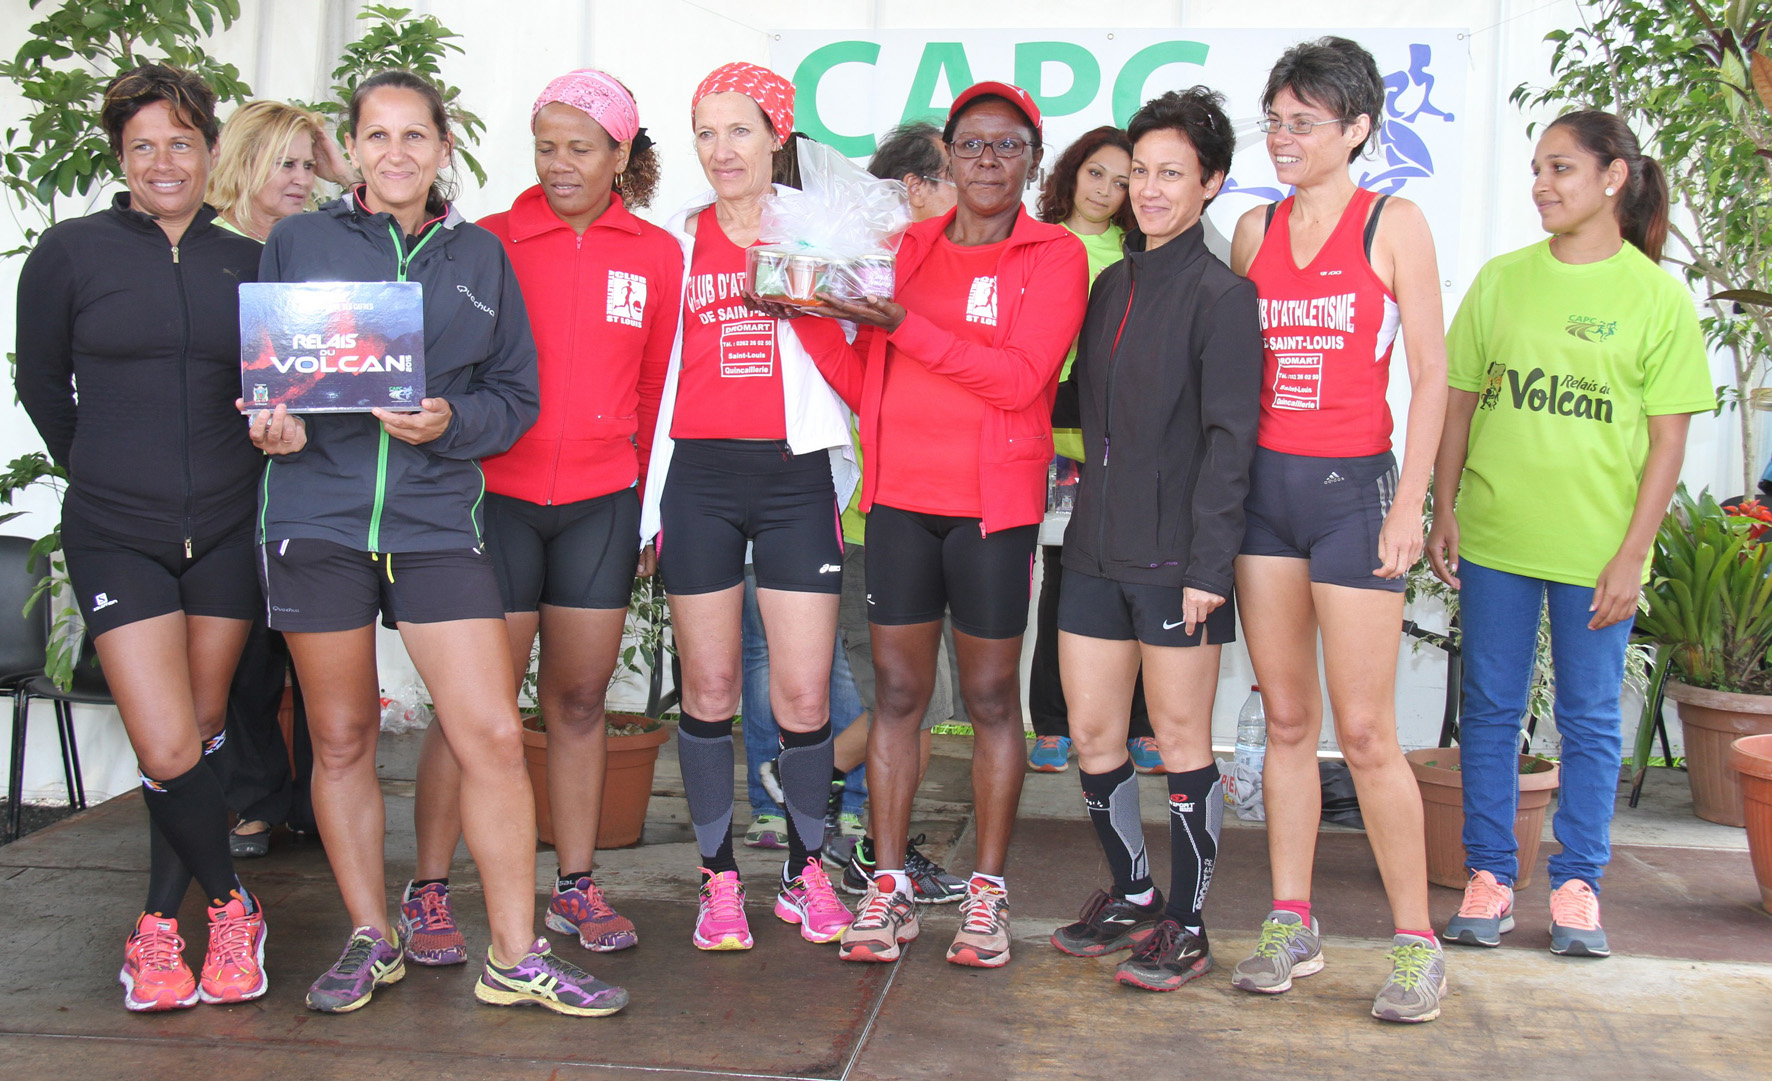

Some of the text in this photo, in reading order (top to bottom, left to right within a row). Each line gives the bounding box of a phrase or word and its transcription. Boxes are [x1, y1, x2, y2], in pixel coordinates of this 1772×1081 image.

[792, 40, 1210, 158] CAPC
[613, 270, 647, 284] CLUB
[456, 284, 496, 317] Quechua
[686, 273, 716, 314] CLUB
[698, 311, 717, 325] DE
[1270, 293, 1356, 333] D'ATHLETISME
[1568, 314, 1598, 324] CAPC
[606, 315, 643, 329] ST LOUIS
[725, 324, 771, 334] DROMART
[292, 333, 359, 350] RELAIS
[1269, 335, 1345, 350] SAINT-LOUIS
[269, 355, 405, 374] VOLCAN
[724, 365, 769, 374] Quincaillerie
[1560, 374, 1598, 392] Relais
[1507, 367, 1613, 424] Volcan
